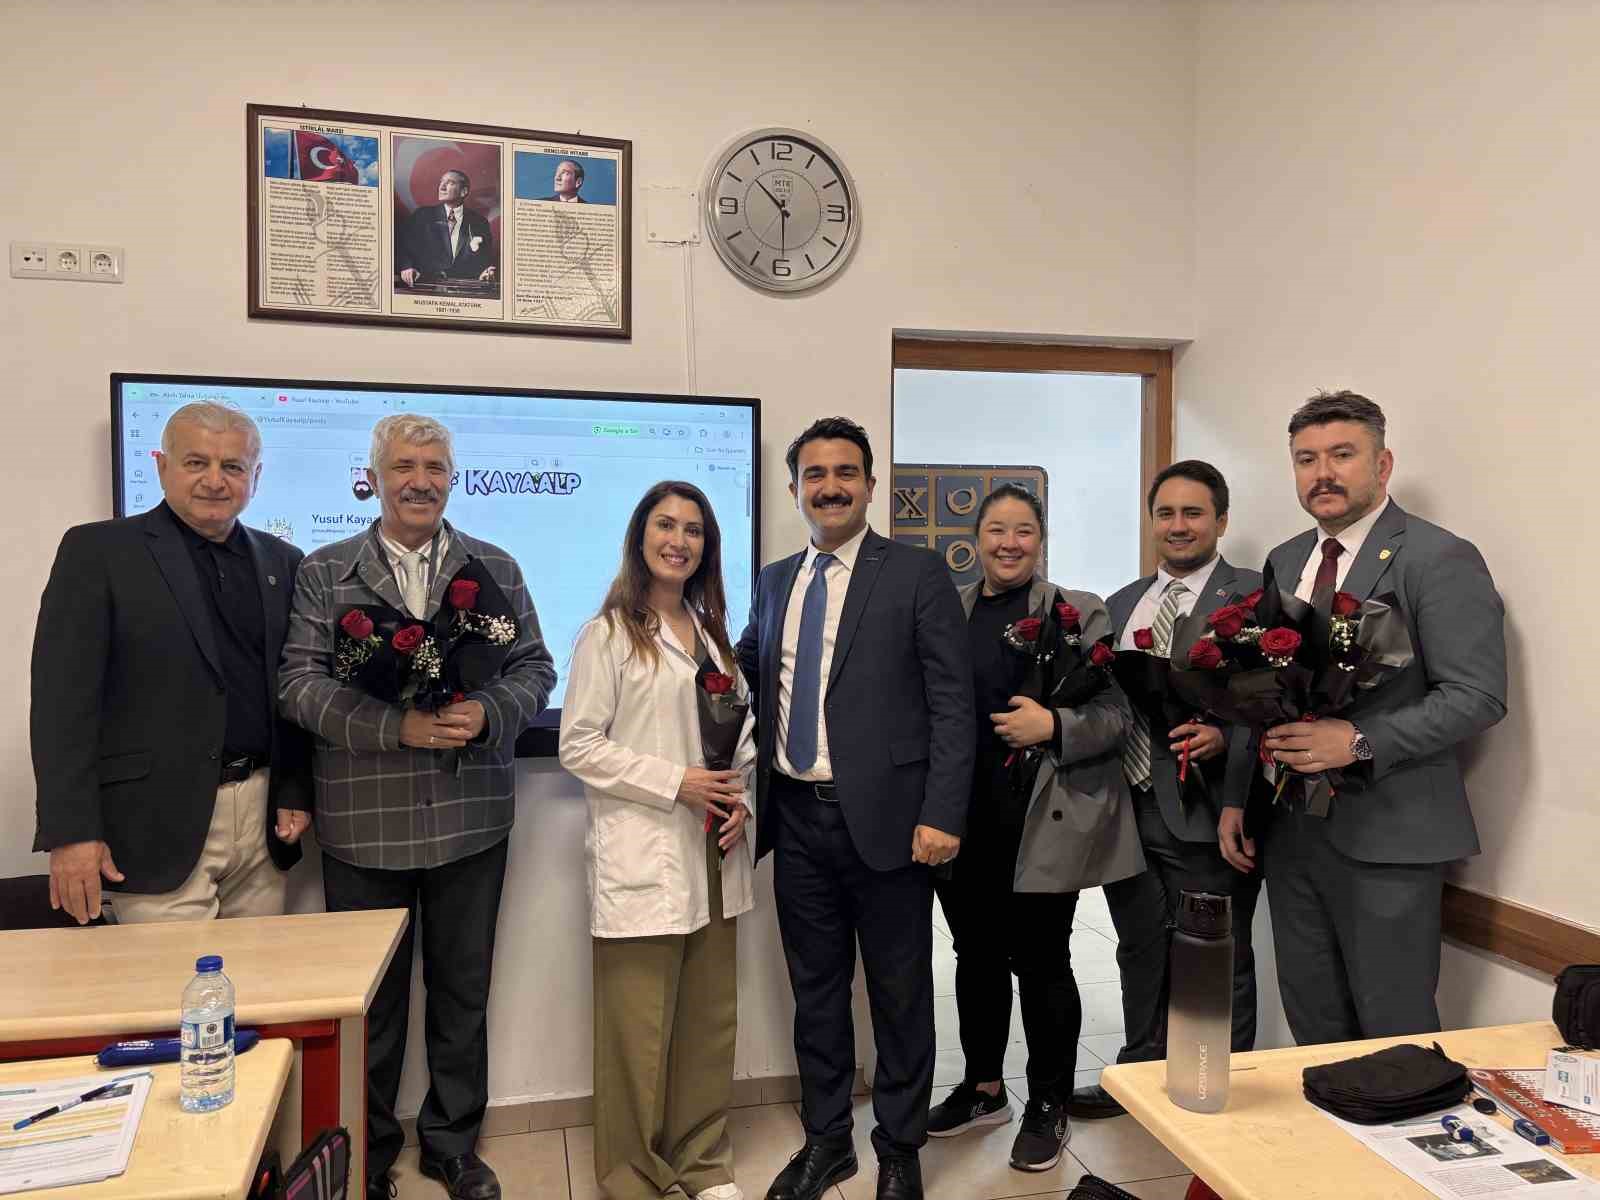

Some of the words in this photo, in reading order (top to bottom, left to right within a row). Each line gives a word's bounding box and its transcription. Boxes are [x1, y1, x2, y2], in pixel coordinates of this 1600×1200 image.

[771, 142, 793, 161] 12
[719, 197, 738, 215] 9
[827, 204, 845, 222] 3
[772, 258, 792, 277] 6
[465, 469, 582, 496] KAYAALP
[311, 513, 345, 524] Yusuf
[346, 514, 378, 527] Kaya
